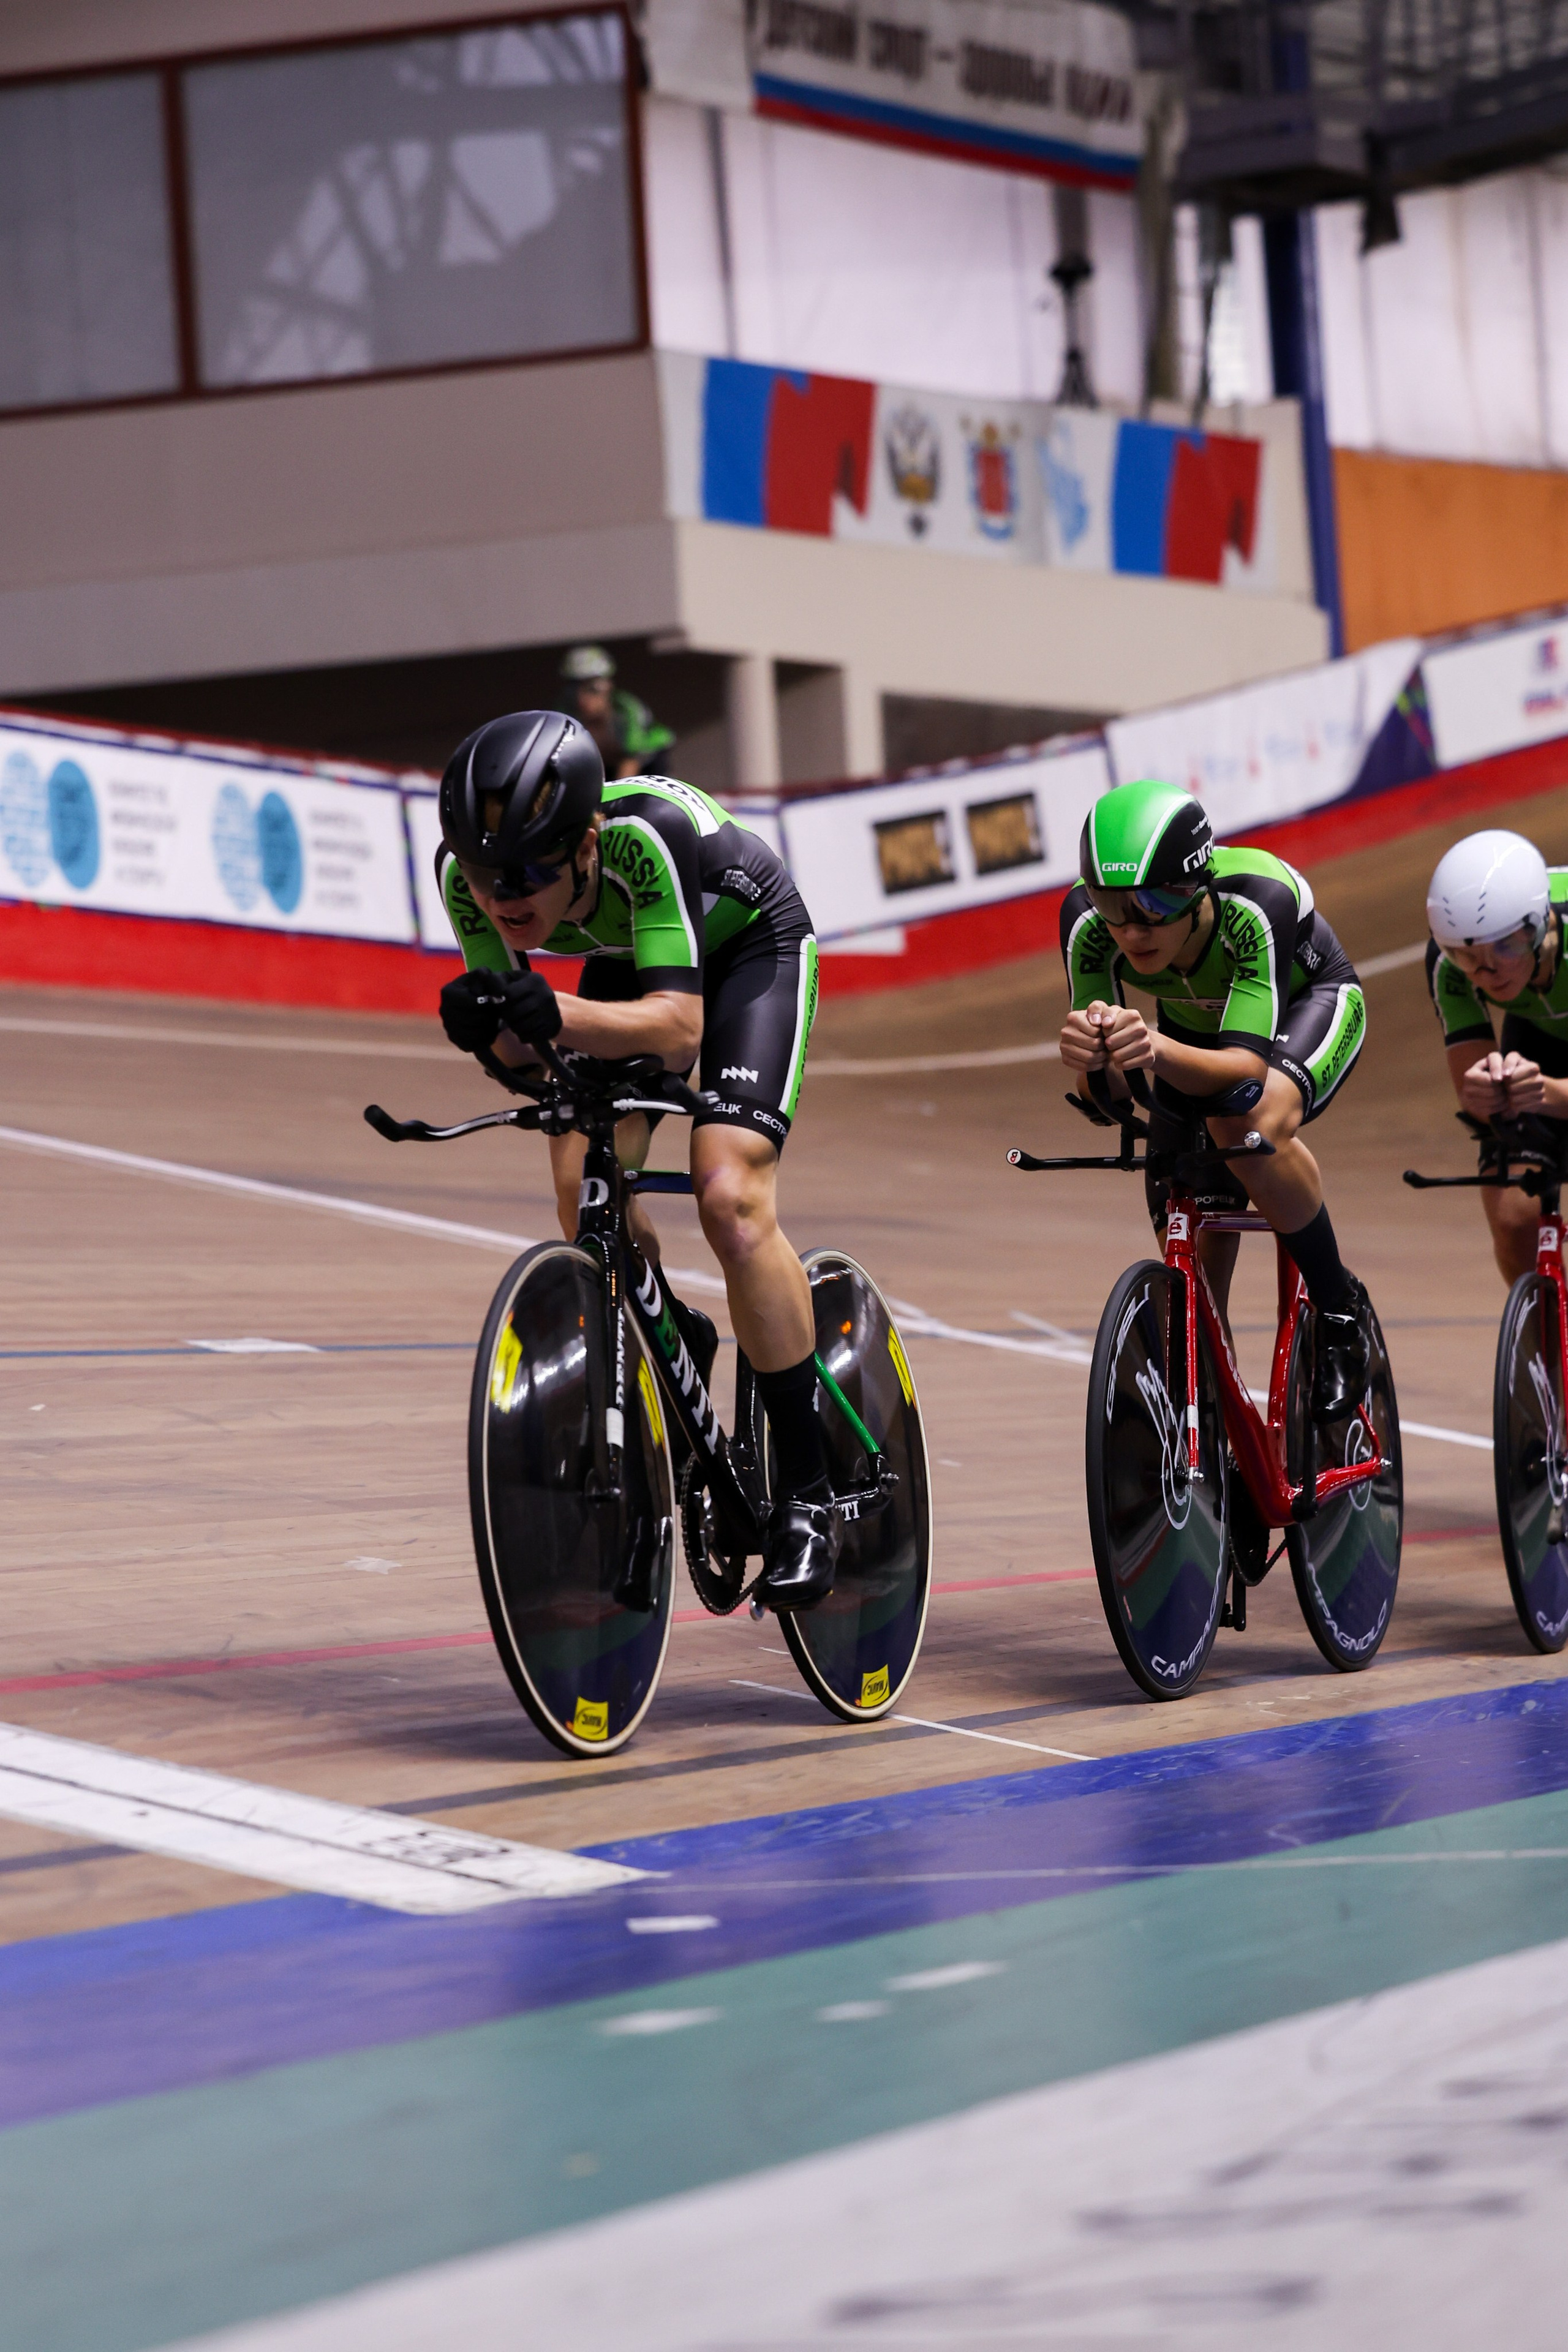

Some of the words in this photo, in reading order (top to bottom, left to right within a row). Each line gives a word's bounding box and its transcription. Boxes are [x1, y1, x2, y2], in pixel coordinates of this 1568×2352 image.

[1101, 862, 1138, 872] GIRO
[1224, 903, 1259, 982] RUSSIA
[1332, 1001, 1364, 1074] PETERSBURG
[635, 1257, 721, 1456] DENTI
